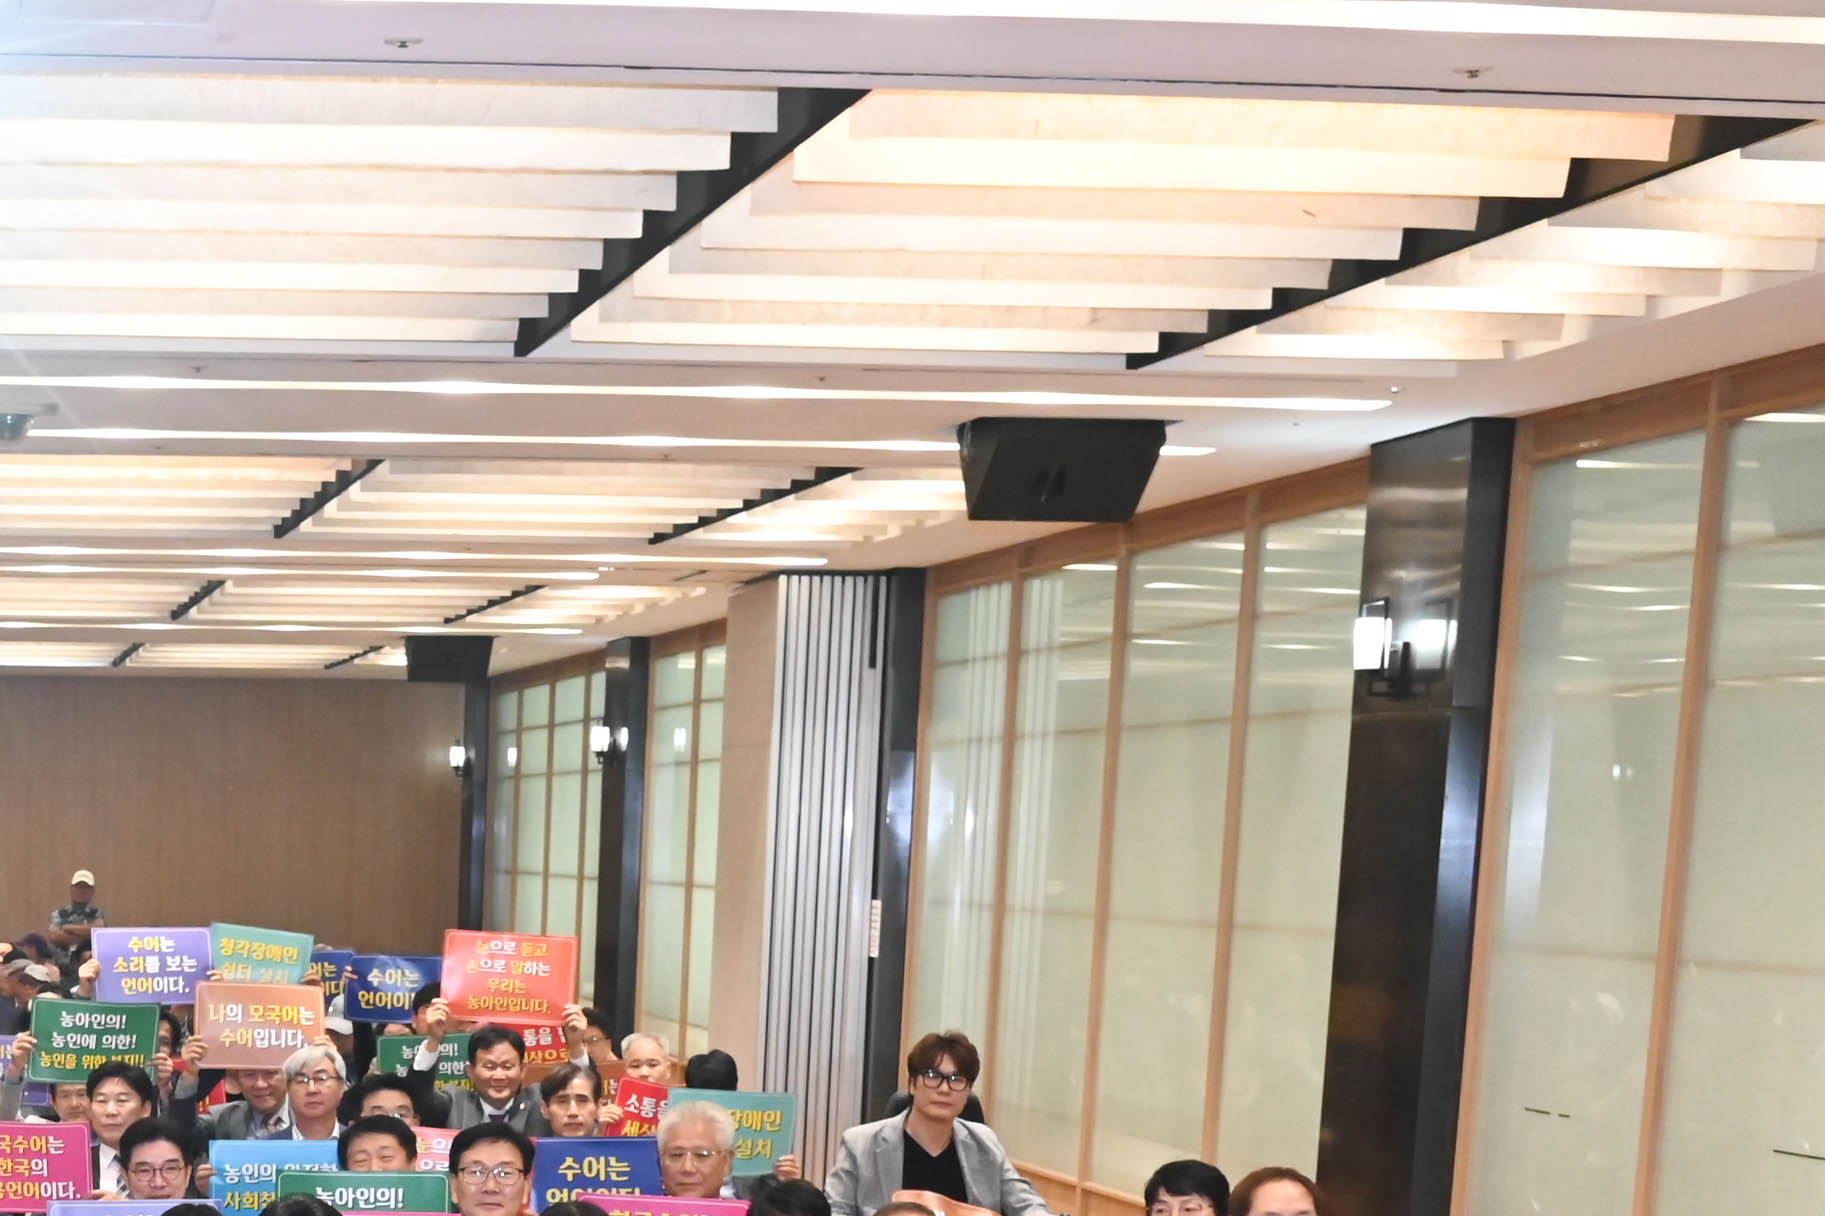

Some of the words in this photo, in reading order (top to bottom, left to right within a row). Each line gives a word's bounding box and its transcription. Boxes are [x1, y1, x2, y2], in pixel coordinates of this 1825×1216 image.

[128, 936, 175, 953] 수어는
[220, 937, 299, 965] 청각장애인
[521, 942, 547, 957] 듣고
[113, 956, 160, 974] 소리를
[166, 955, 197, 973] 보는
[511, 960, 552, 976] 말하는
[121, 976, 190, 995] 언어이다.
[367, 968, 419, 988] 수어는
[488, 978, 528, 993] 우리는
[208, 1003, 242, 1023] 나의
[248, 1004, 315, 1025] 모국어는
[467, 995, 551, 1014] 농아인입니다.
[60, 1011, 127, 1029] 농아인의!
[51, 1032, 96, 1049] 농인에
[101, 1034, 137, 1050] 의한!
[219, 1027, 309, 1049] 수어입니다.
[40, 1051, 78, 1069] 농인을
[82, 1055, 107, 1070] 위한
[624, 1094, 669, 1118] 소통을
[736, 1139, 773, 1159] 설치
[224, 1163, 277, 1184] 농인의
[558, 1156, 632, 1182] 수어는
